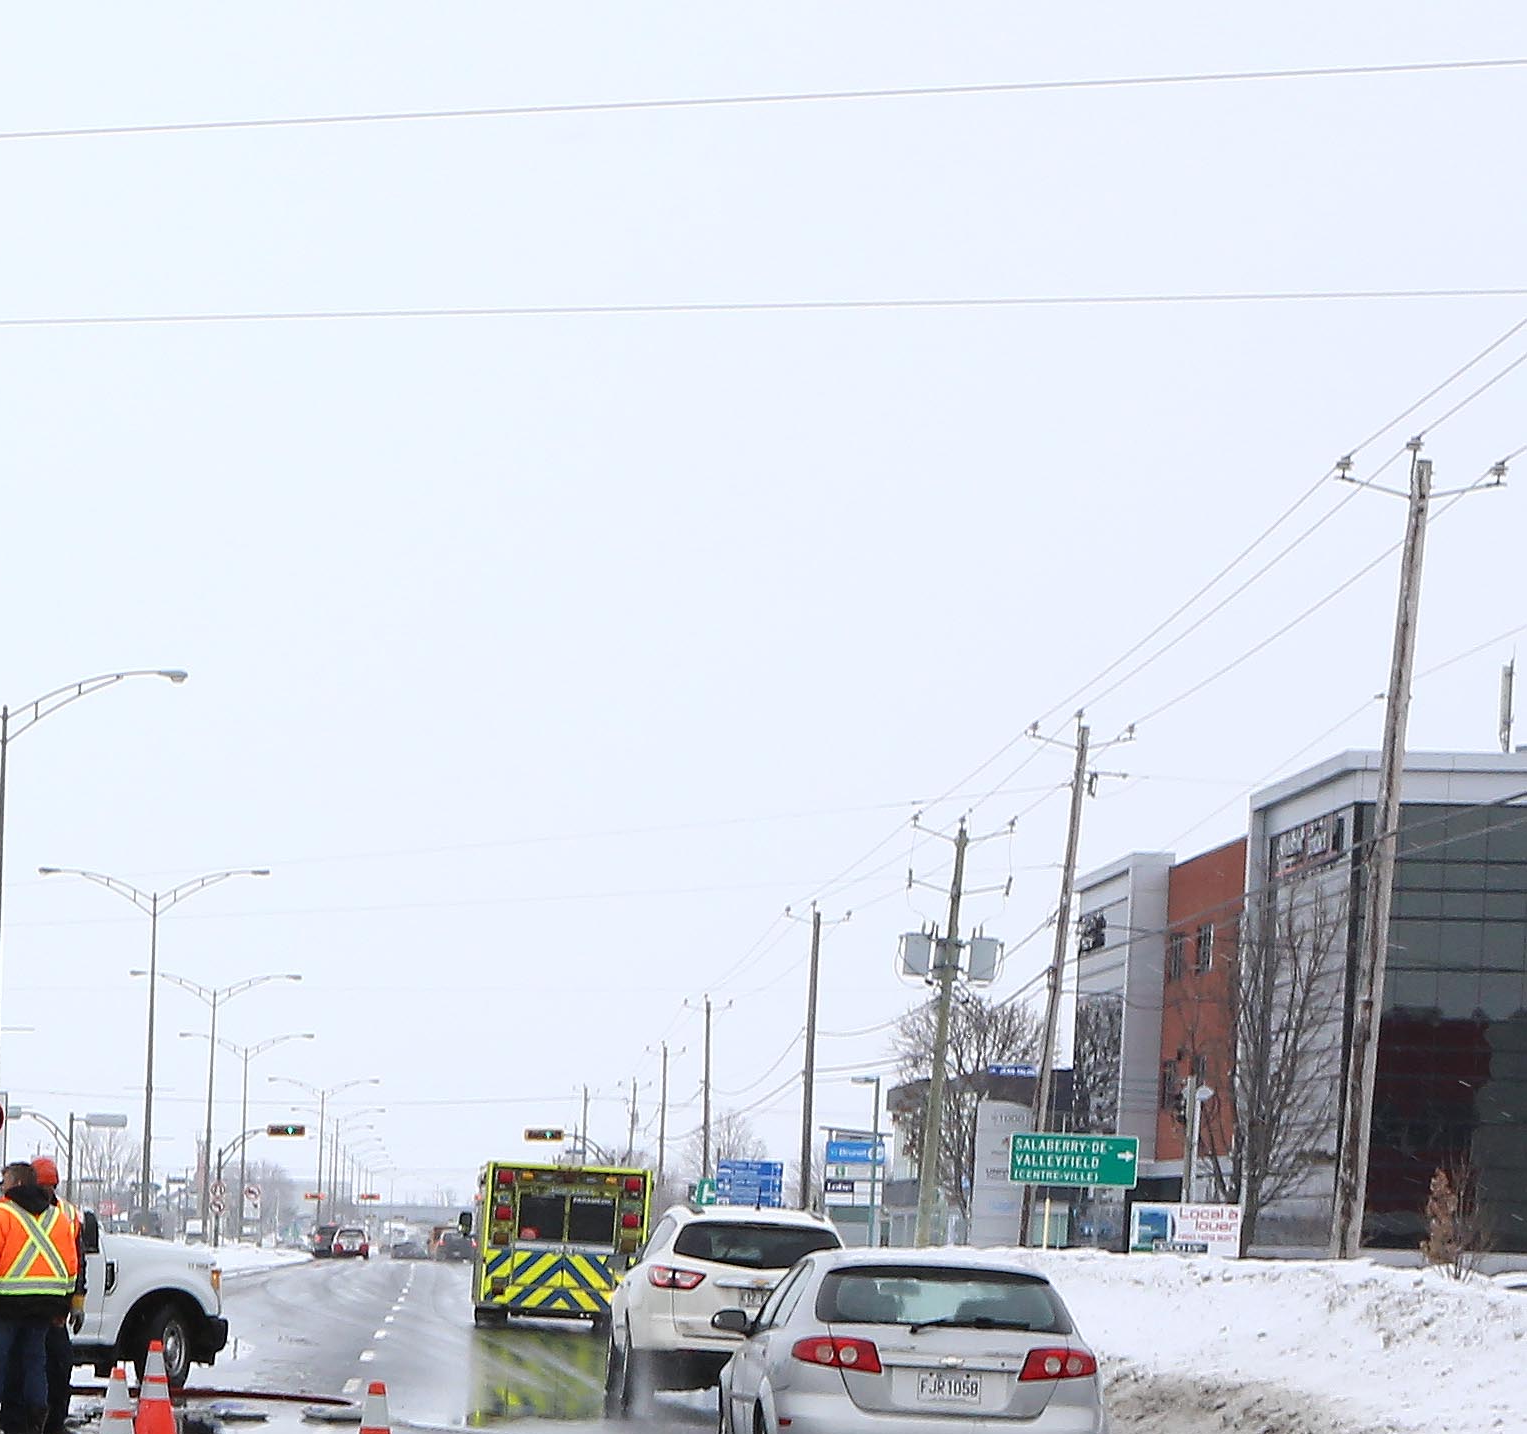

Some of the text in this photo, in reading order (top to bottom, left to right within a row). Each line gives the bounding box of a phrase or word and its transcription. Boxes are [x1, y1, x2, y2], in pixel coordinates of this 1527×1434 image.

[1015, 1154, 1100, 1169] VALLEYFIELD
[1179, 1206, 1224, 1220] Local
[1195, 1220, 1238, 1232] louer
